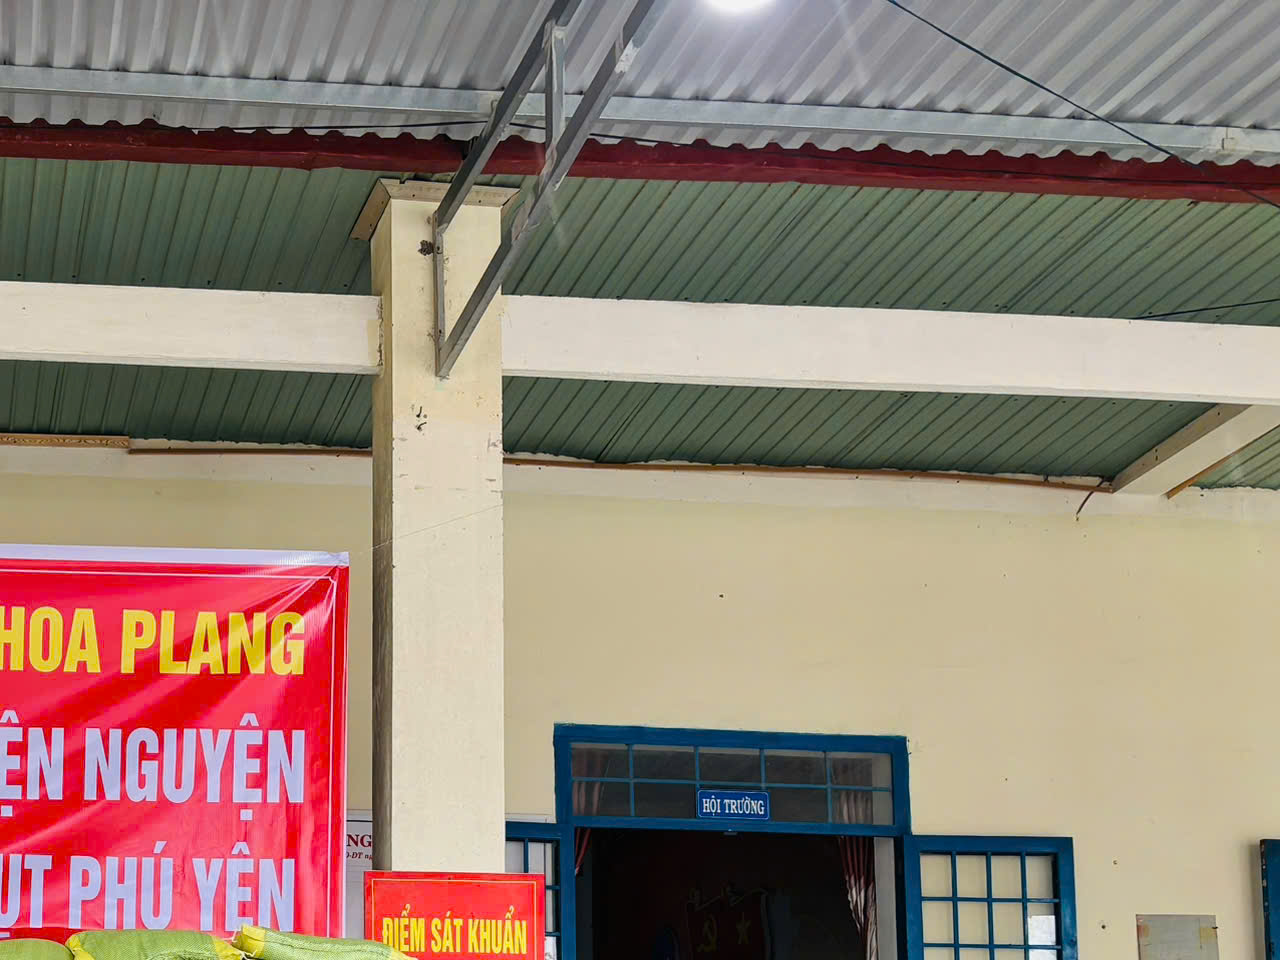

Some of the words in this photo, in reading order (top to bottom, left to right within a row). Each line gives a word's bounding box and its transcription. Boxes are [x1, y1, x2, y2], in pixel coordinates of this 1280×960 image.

[121, 609, 305, 676] PLANG
[83, 713, 306, 822] NGUYỆN
[702, 795, 721, 816] HỘI
[724, 796, 765, 814] TRƯỜNG
[67, 840, 175, 931] PHÚ
[191, 841, 296, 933] YÊN
[382, 904, 425, 952] ĐIỂM
[431, 911, 463, 953] SÁT
[469, 905, 527, 954] KHUẨN
